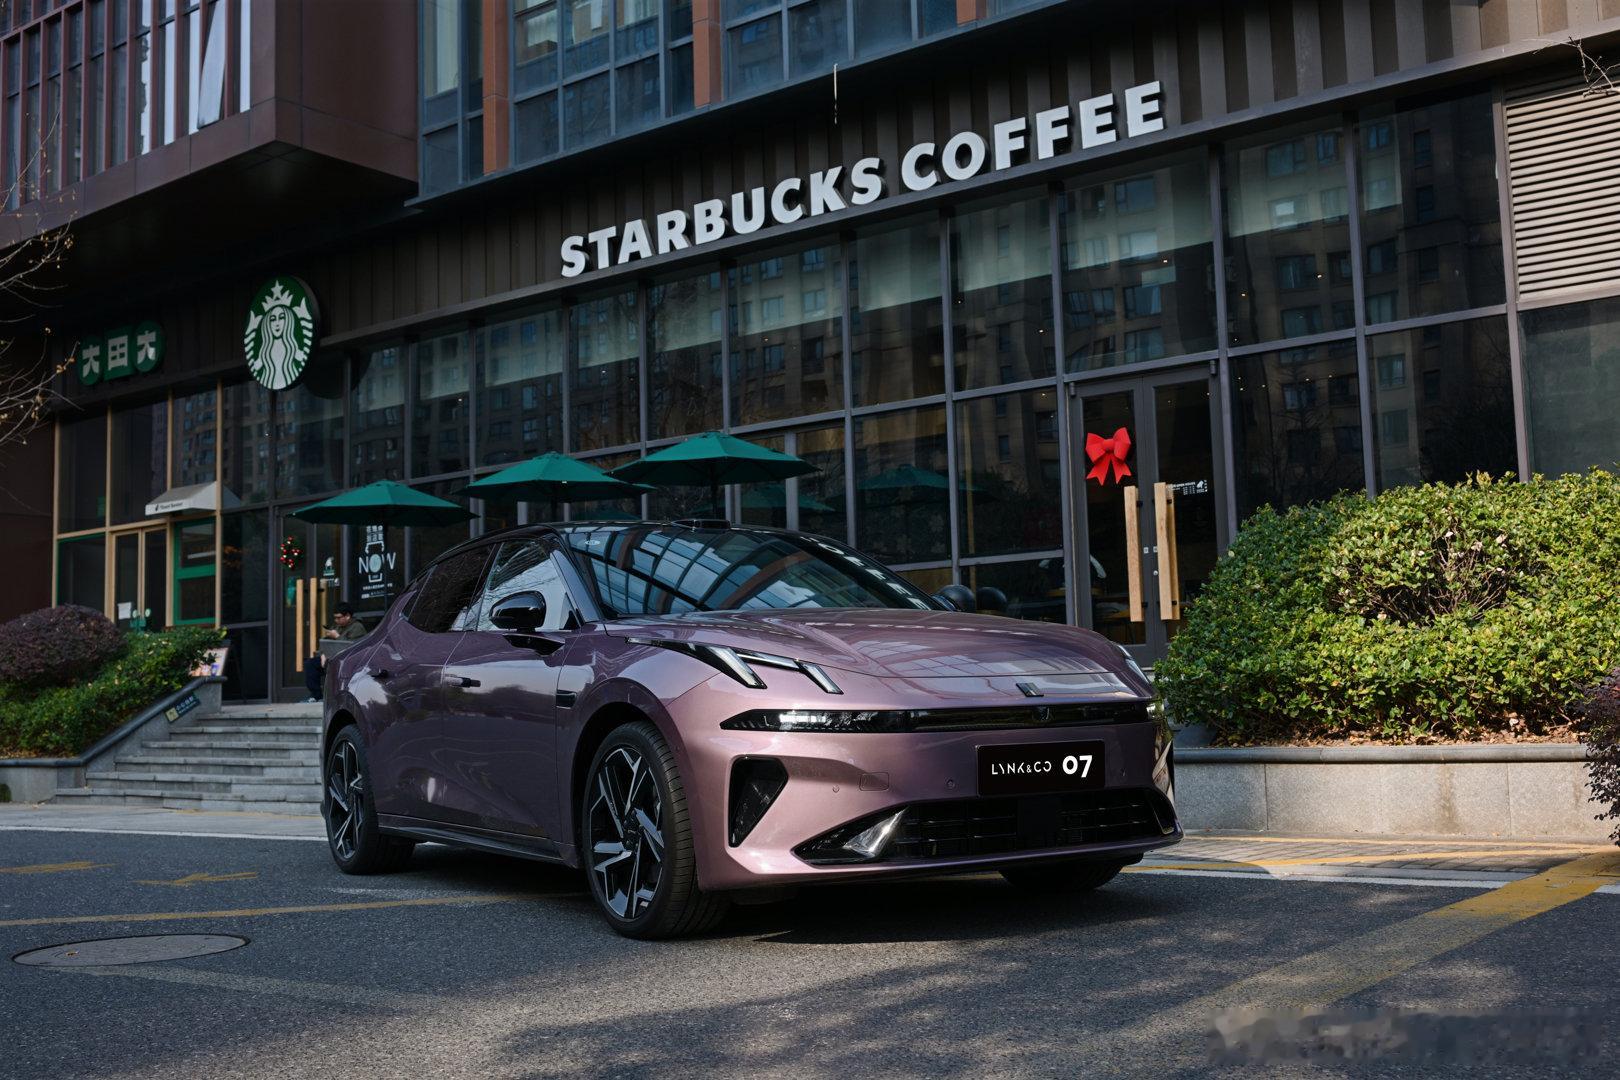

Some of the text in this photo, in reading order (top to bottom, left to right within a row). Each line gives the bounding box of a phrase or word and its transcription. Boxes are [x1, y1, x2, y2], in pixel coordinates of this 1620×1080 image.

[560, 80, 1166, 278] STARBUCKS COFFEE
[358, 551, 397, 574] NOW
[1062, 754, 1093, 778] 07
